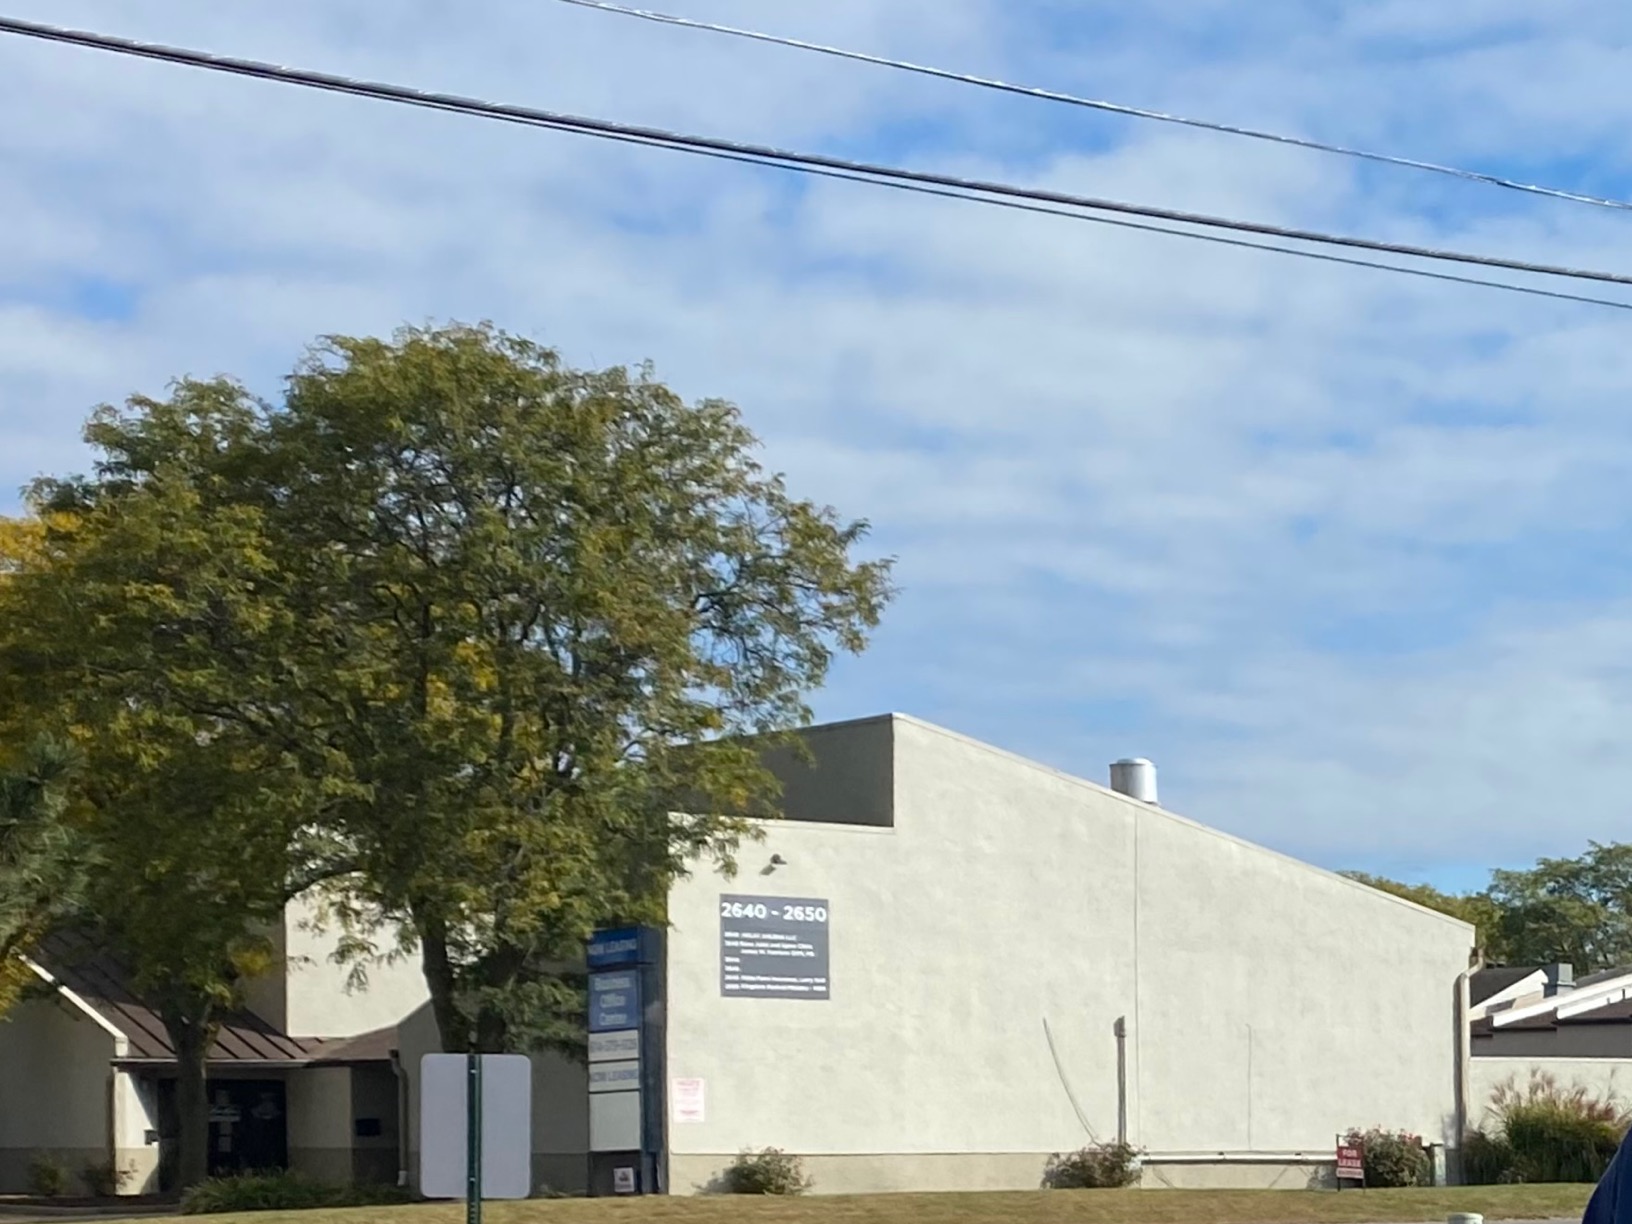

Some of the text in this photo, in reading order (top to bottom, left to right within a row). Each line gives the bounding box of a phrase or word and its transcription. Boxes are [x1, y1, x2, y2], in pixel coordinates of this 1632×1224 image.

[721, 902, 767, 919] 2640
[782, 905, 827, 922] 2650
[1342, 1149, 1358, 1158] FOR
[1338, 1159, 1362, 1168] LEASE
